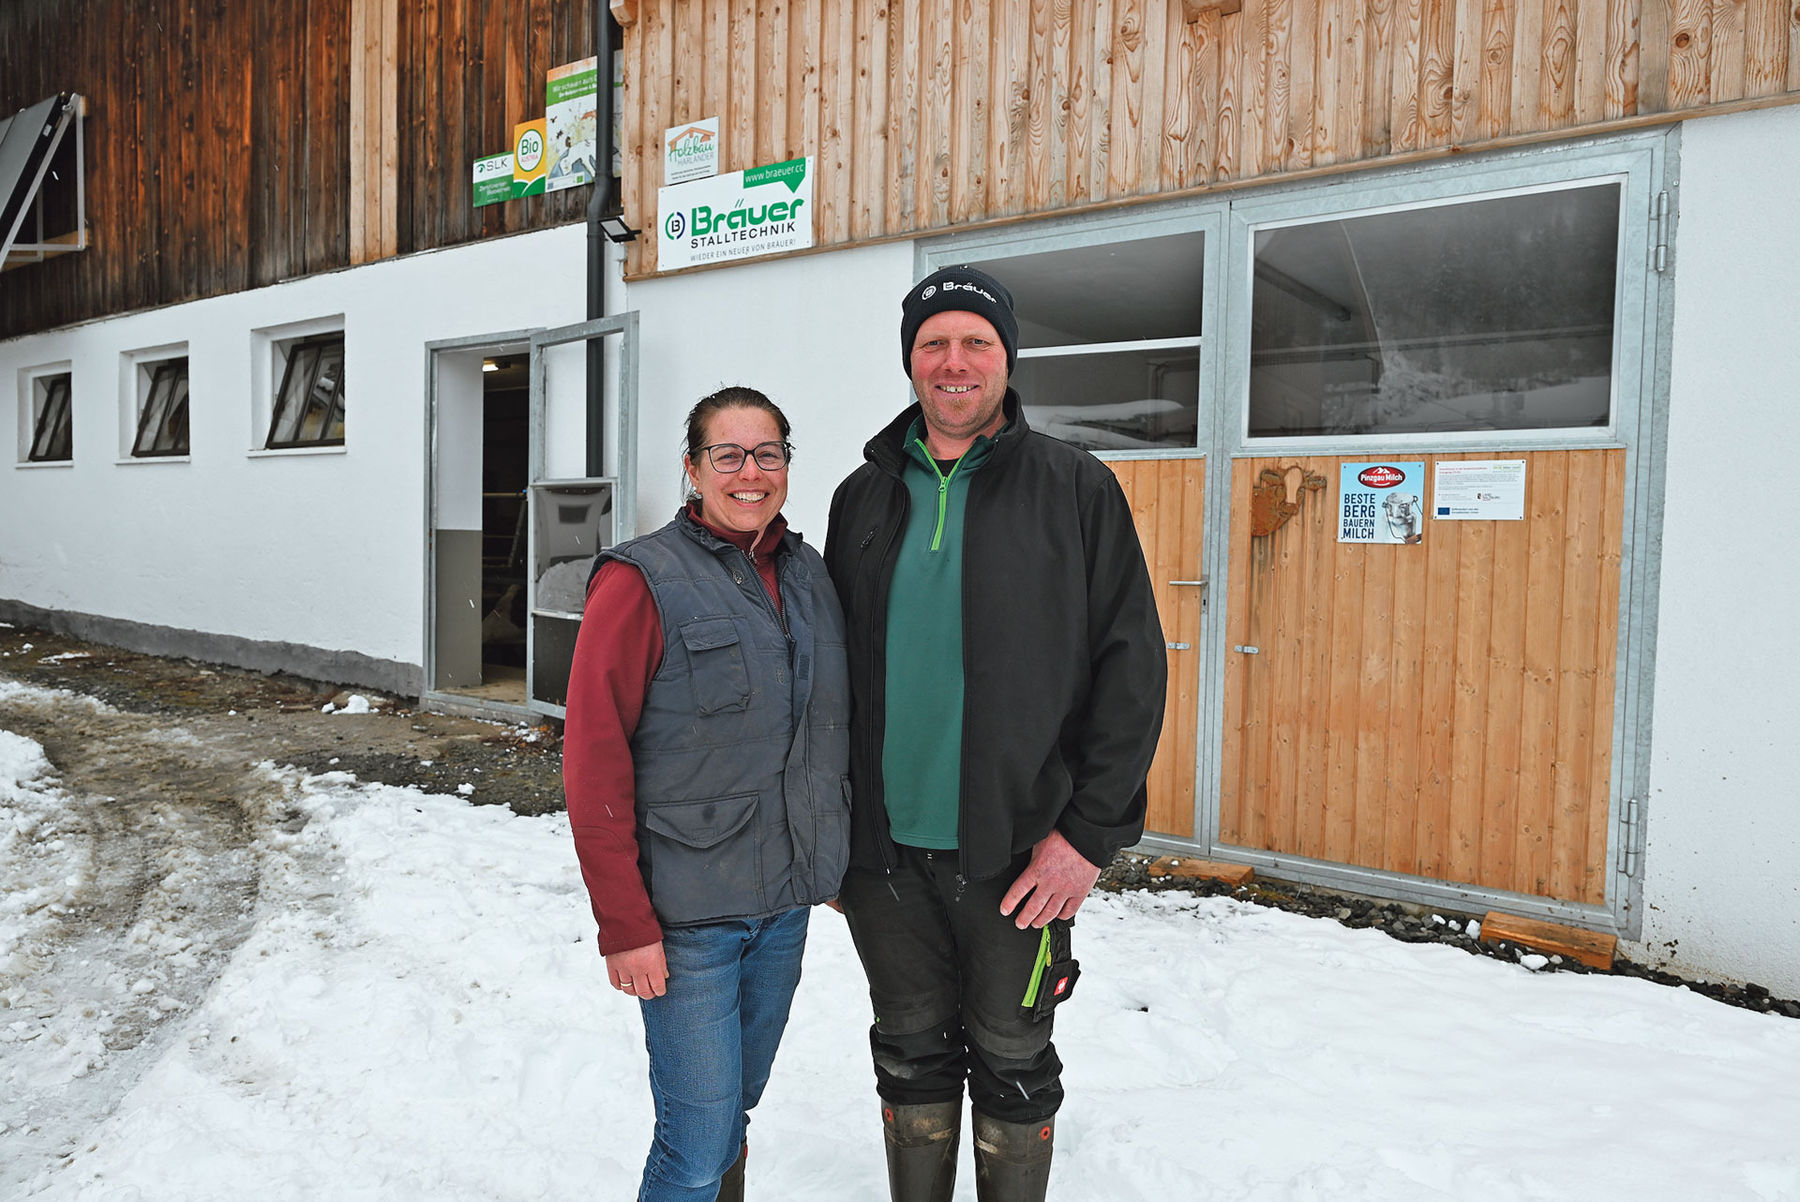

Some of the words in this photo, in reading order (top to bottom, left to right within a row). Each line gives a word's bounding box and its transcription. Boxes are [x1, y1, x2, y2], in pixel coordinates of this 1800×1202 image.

[521, 137, 539, 156] Bio
[669, 135, 714, 162] Holzbau
[486, 157, 508, 171] SLK
[745, 164, 804, 183] www.braeuer.cc
[691, 198, 805, 237] Bräuer
[691, 222, 796, 249] STALLTECHNIK
[691, 252, 714, 262] WIEDER
[716, 249, 727, 258] EIN
[728, 247, 750, 256] NEUER
[751, 244, 766, 252] VON
[943, 281, 997, 304] Bräuer
[1360, 473, 1385, 483] Pinzgau
[1385, 473, 1403, 481] Milch
[1344, 493, 1376, 504] BESTE
[1344, 505, 1376, 518] BERG
[1343, 519, 1375, 528] BAUERN
[1343, 528, 1374, 539] MILCH
